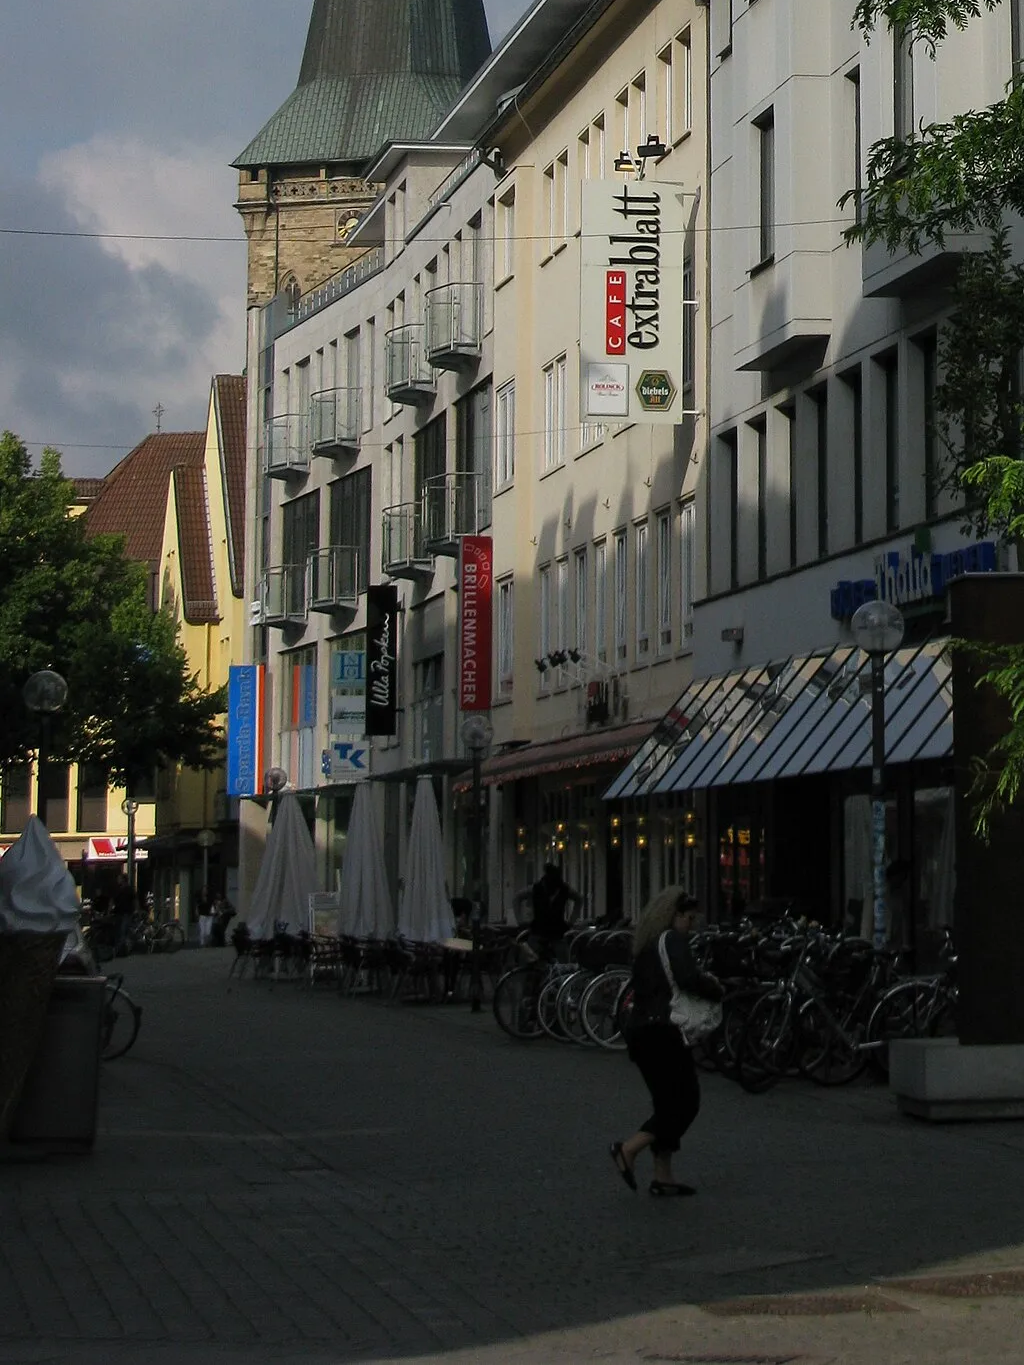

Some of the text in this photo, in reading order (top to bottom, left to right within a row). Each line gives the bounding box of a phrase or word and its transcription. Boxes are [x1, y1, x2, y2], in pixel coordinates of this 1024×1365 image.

[608, 275, 622, 348] CAFE
[609, 184, 661, 349] extrablatt
[370, 613, 395, 706] Ulla Popken
[463, 563, 477, 704] BRILLENMACHER
[235, 667, 253, 791] Sparda-Bank
[334, 743, 367, 768] TK
